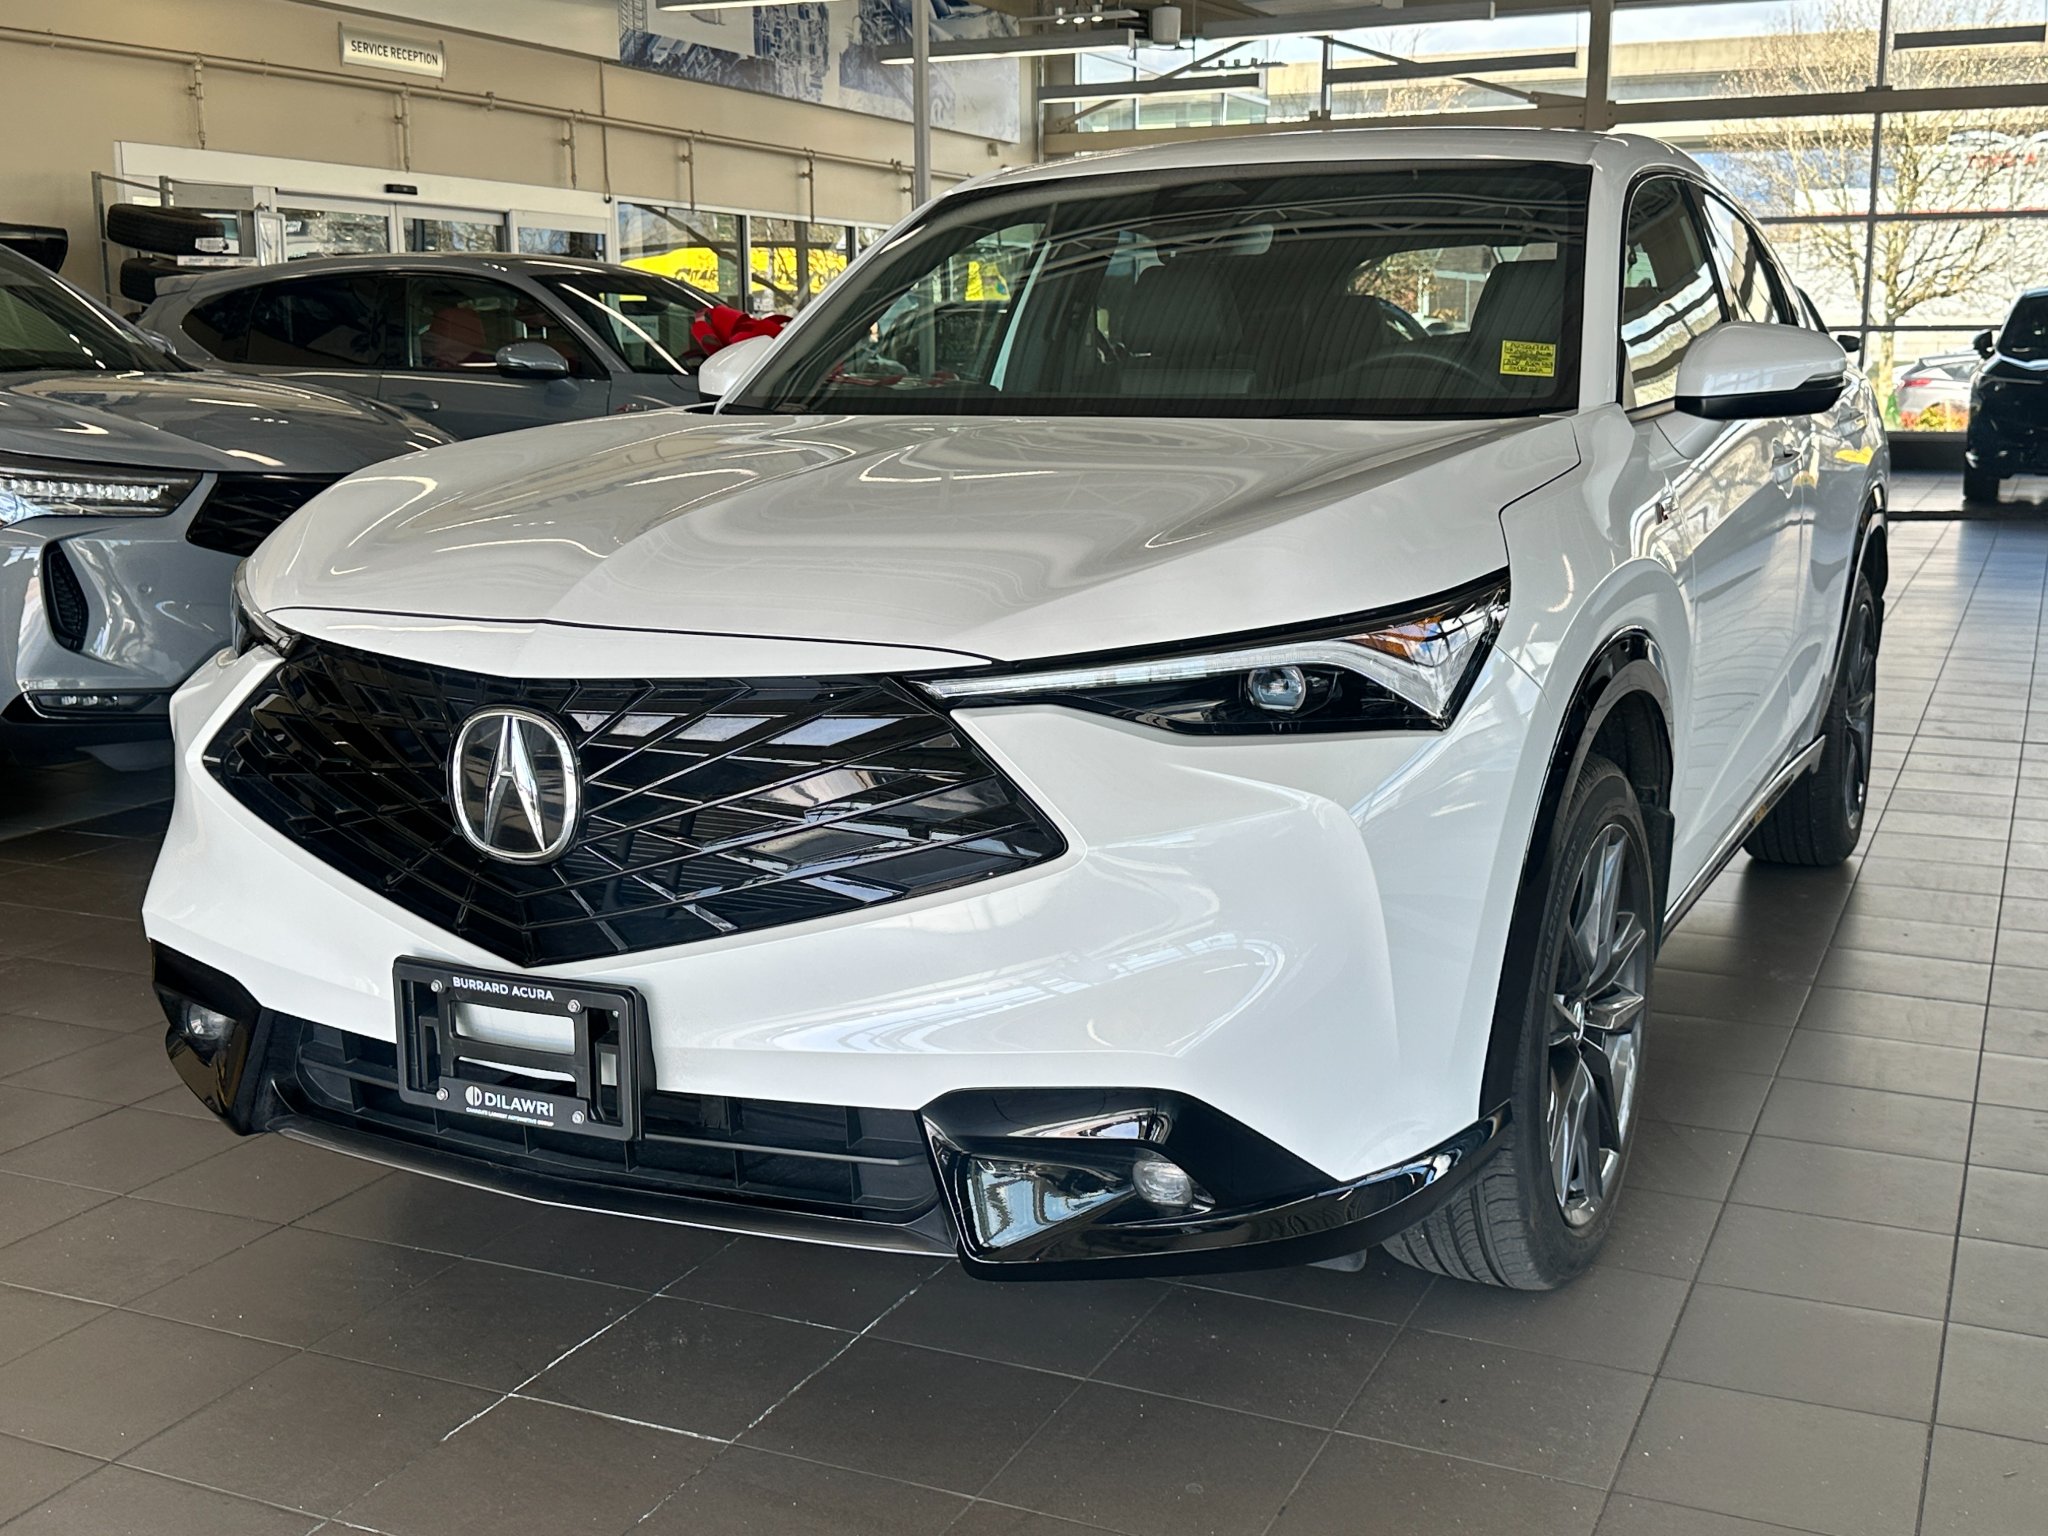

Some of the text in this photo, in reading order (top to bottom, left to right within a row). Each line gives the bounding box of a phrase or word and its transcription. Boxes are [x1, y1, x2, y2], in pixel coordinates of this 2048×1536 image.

[351, 40, 438, 65] SERVICE RECEPTION
[452, 976, 555, 1001] BURRARD ACURA
[484, 1092, 554, 1117] DILAWRI
